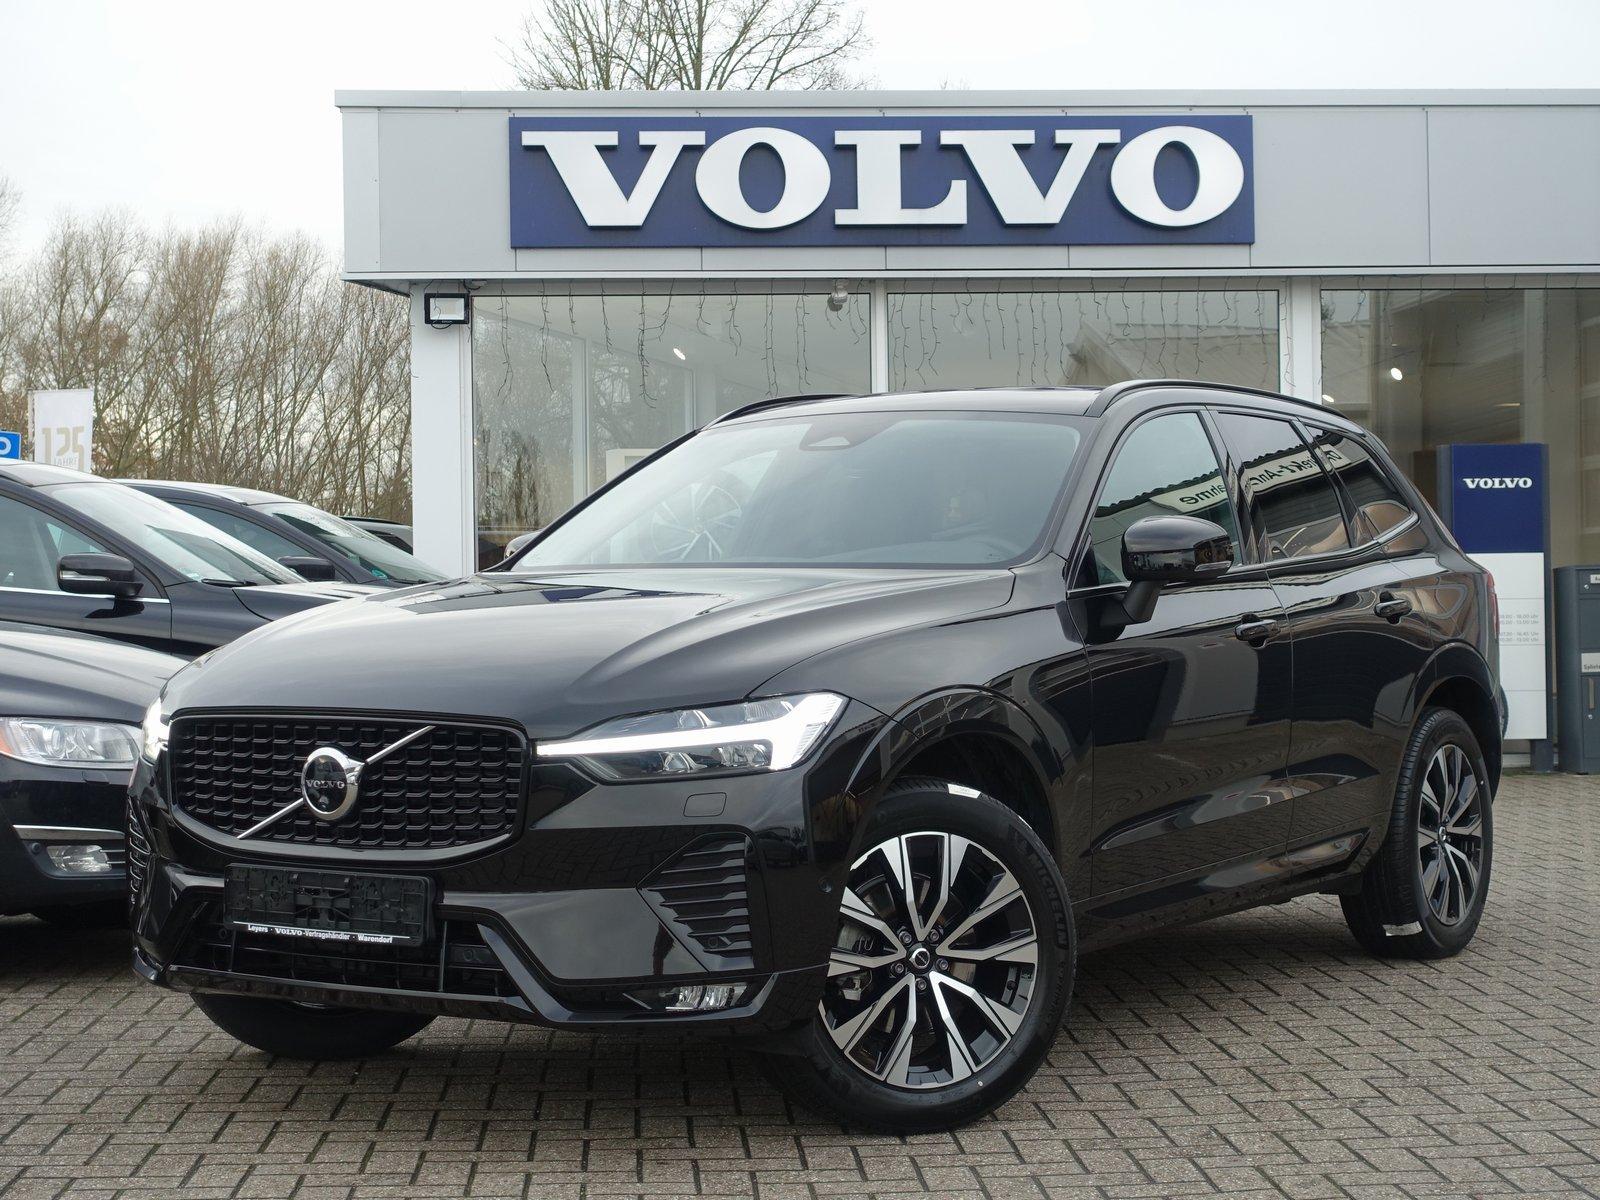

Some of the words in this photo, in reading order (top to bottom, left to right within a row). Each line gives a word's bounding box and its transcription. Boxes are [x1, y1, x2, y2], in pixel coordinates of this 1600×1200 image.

[521, 125, 1245, 230] VOLVO
[1463, 477, 1533, 489] VOLVO
[305, 780, 345, 789] VOLVO
[357, 933, 393, 943] Warendorf
